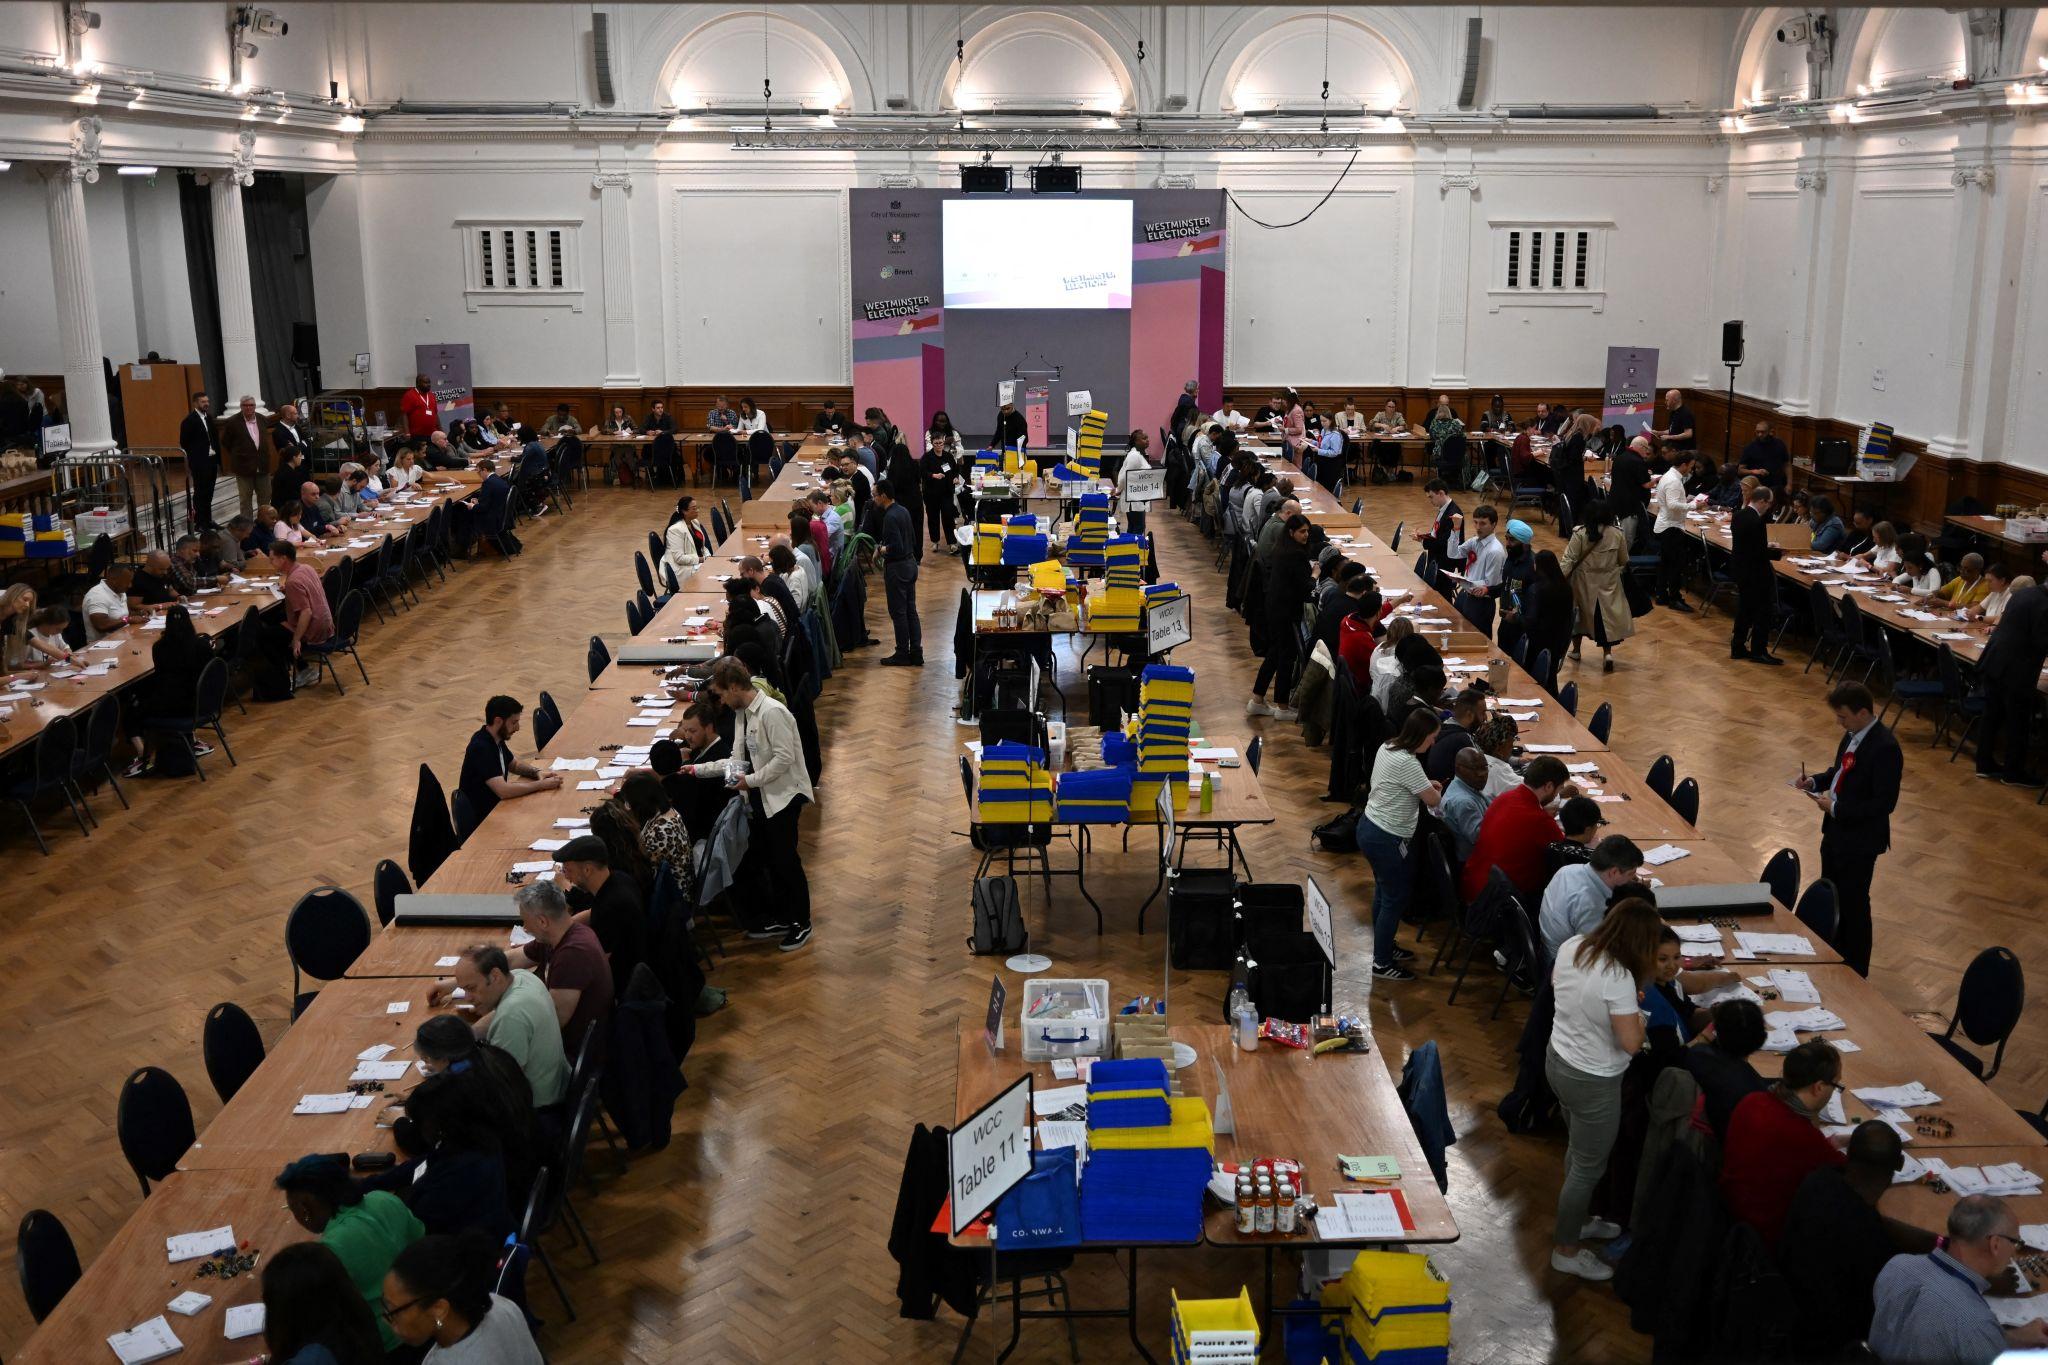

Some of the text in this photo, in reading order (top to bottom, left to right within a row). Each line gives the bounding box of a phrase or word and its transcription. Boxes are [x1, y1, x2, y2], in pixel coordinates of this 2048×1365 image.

[1145, 217, 1211, 232] WESTMINSTER
[1147, 226, 1201, 241] ELECTIONS
[894, 268, 913, 276] Brent
[865, 295, 930, 312] WESTMINSTER
[867, 305, 922, 320] ELECTIONS
[1610, 392, 1648, 400] WESTMINSTER
[1129, 482, 1159, 493] Table 14
[1159, 606, 1174, 619] WCC
[1151, 619, 1182, 641] Table 13
[973, 1110, 1003, 1145] WCC
[957, 1154, 995, 1201] Table
[999, 1133, 1016, 1162] 11
